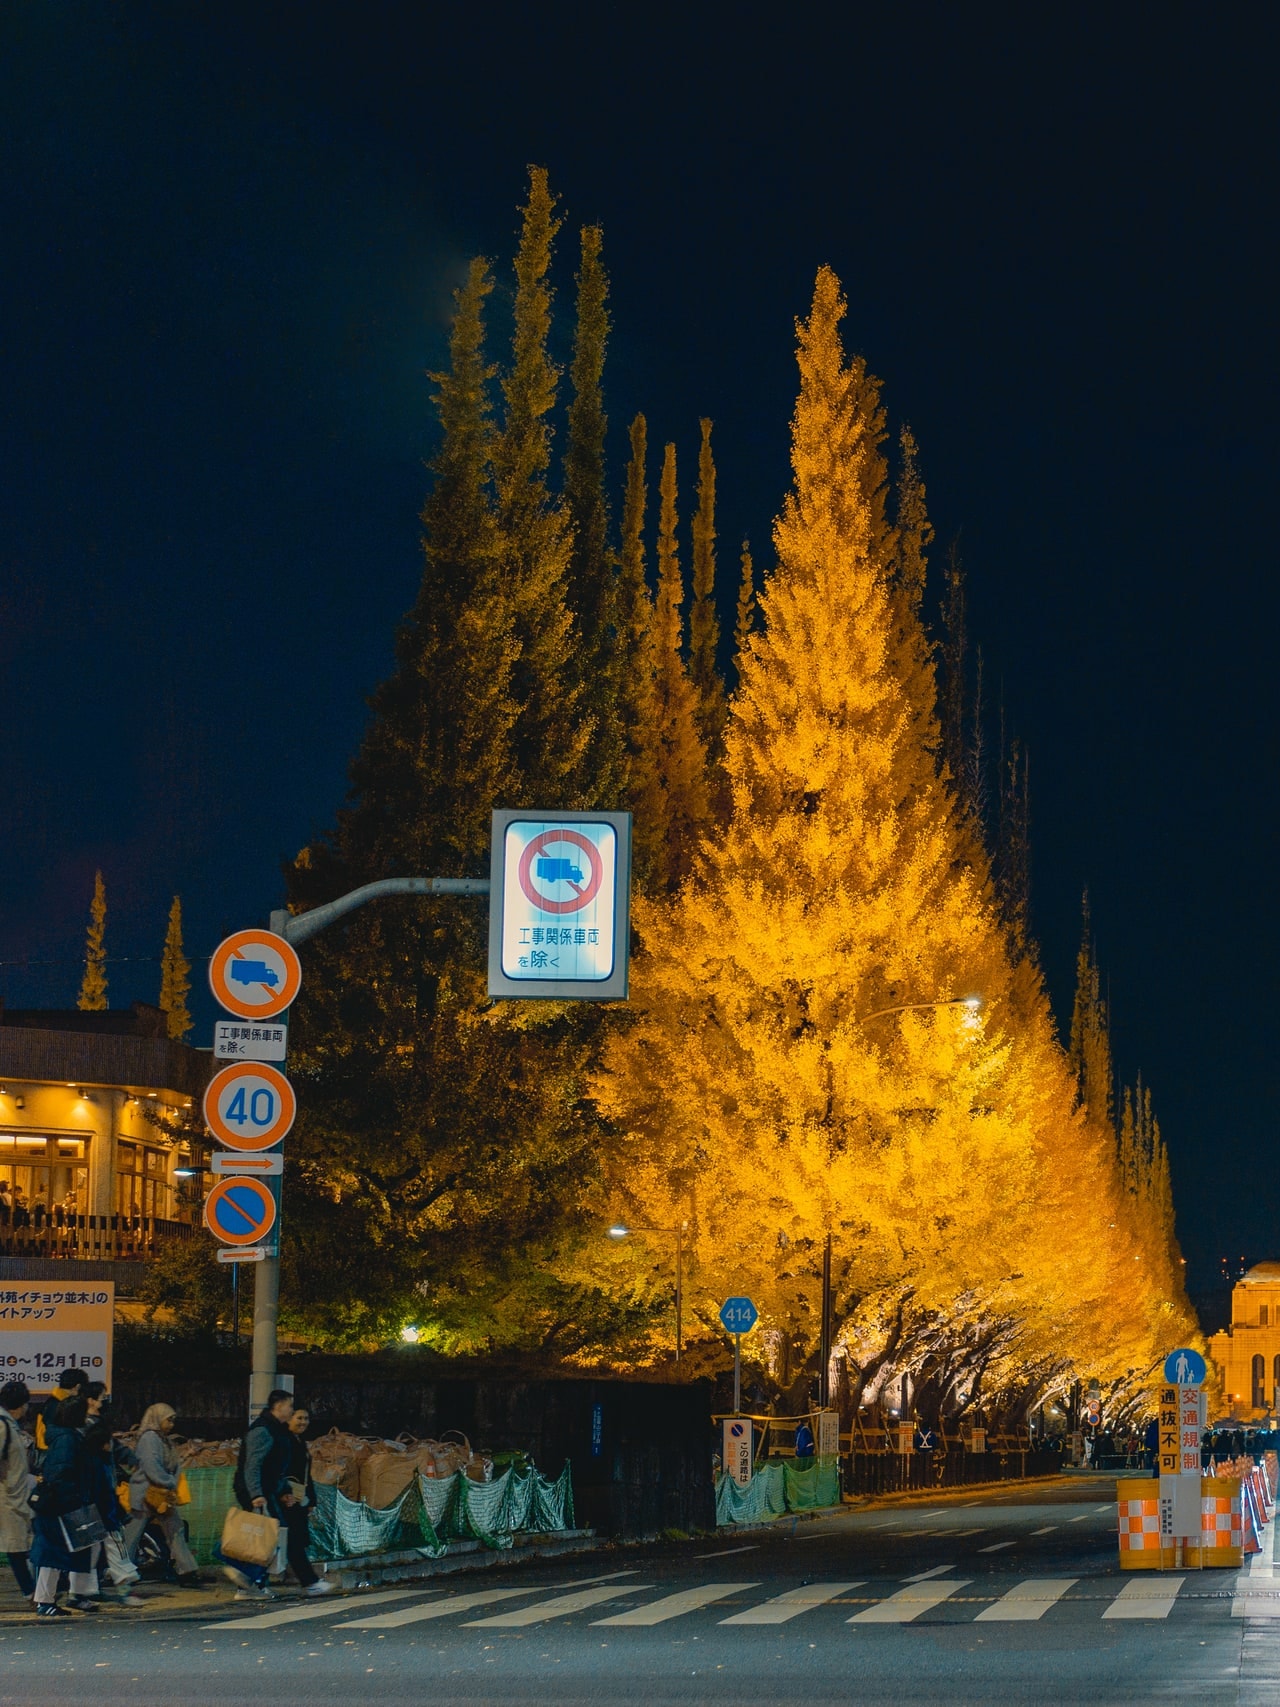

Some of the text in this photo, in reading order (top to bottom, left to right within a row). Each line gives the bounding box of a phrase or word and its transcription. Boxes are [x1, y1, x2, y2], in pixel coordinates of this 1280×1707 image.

[519, 927, 599, 946] 工事関係車両
[518, 950, 560, 968] を除く
[219, 1027, 283, 1042] 工事関係車両
[219, 1041, 246, 1054] を除く
[225, 1087, 274, 1126] 40
[725, 1307, 752, 1322] 414
[1182, 1388, 1199, 1469] 交通規制
